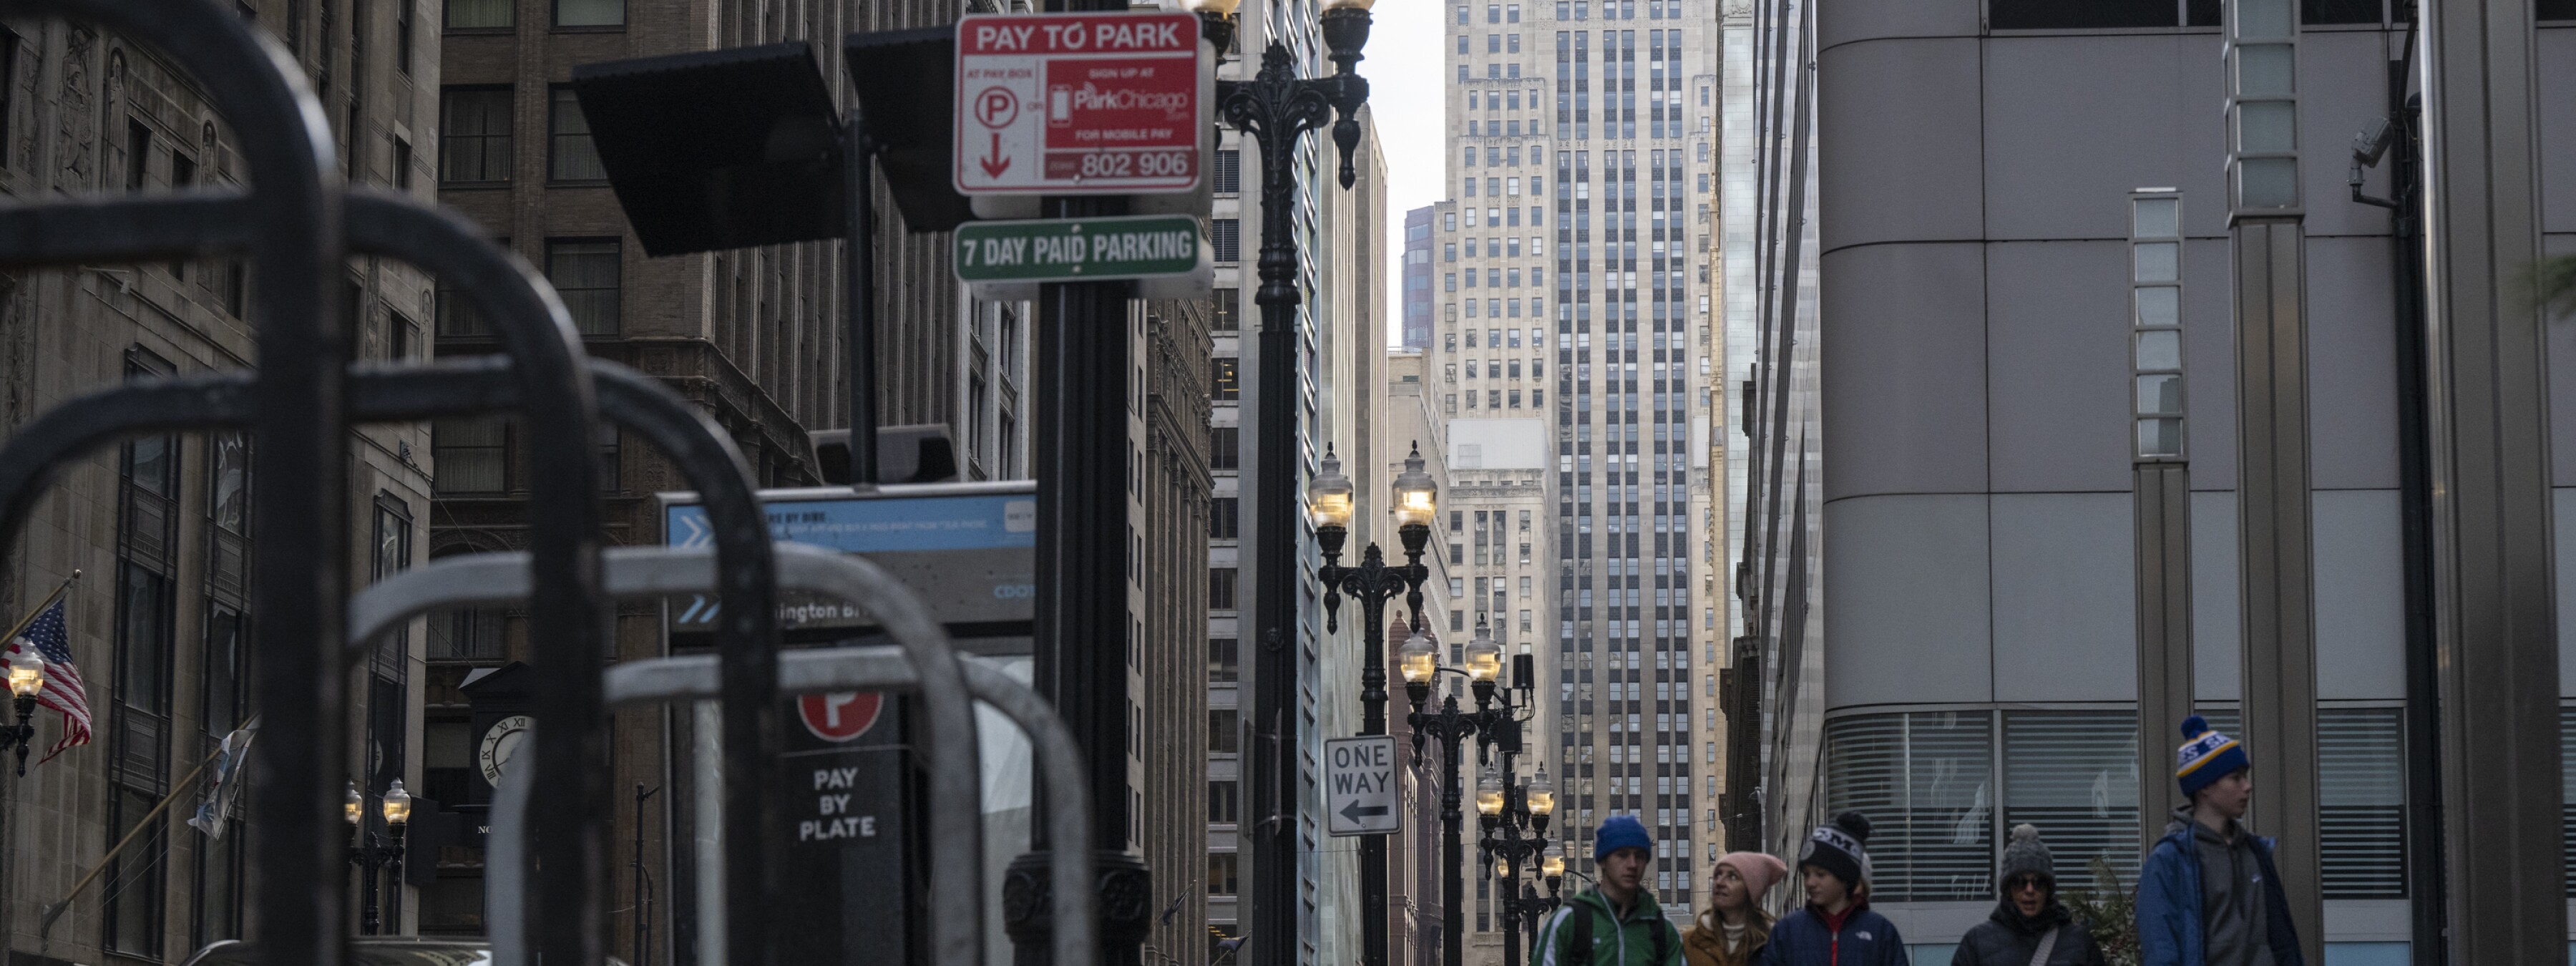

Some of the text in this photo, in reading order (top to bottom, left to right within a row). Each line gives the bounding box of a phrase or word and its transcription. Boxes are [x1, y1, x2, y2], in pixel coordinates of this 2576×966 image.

[977, 22, 1180, 51] PAY TO PARK
[1120, 68, 1138, 78] UP
[1140, 67, 1155, 77] AT
[987, 94, 1009, 122] P
[1074, 89, 1188, 113] ParkChicago
[1075, 128, 1174, 140] FOR MOBILE PAY
[1081, 152, 1189, 177] 802 906
[962, 231, 1193, 266] 7 DAY PAID PARKING
[776, 602, 838, 623] ington
[1335, 745, 1388, 769] ONE
[814, 766, 859, 791] PAY
[1335, 771, 1390, 795] WAY
[819, 794, 852, 815] BY
[799, 816, 877, 842] PLATE
